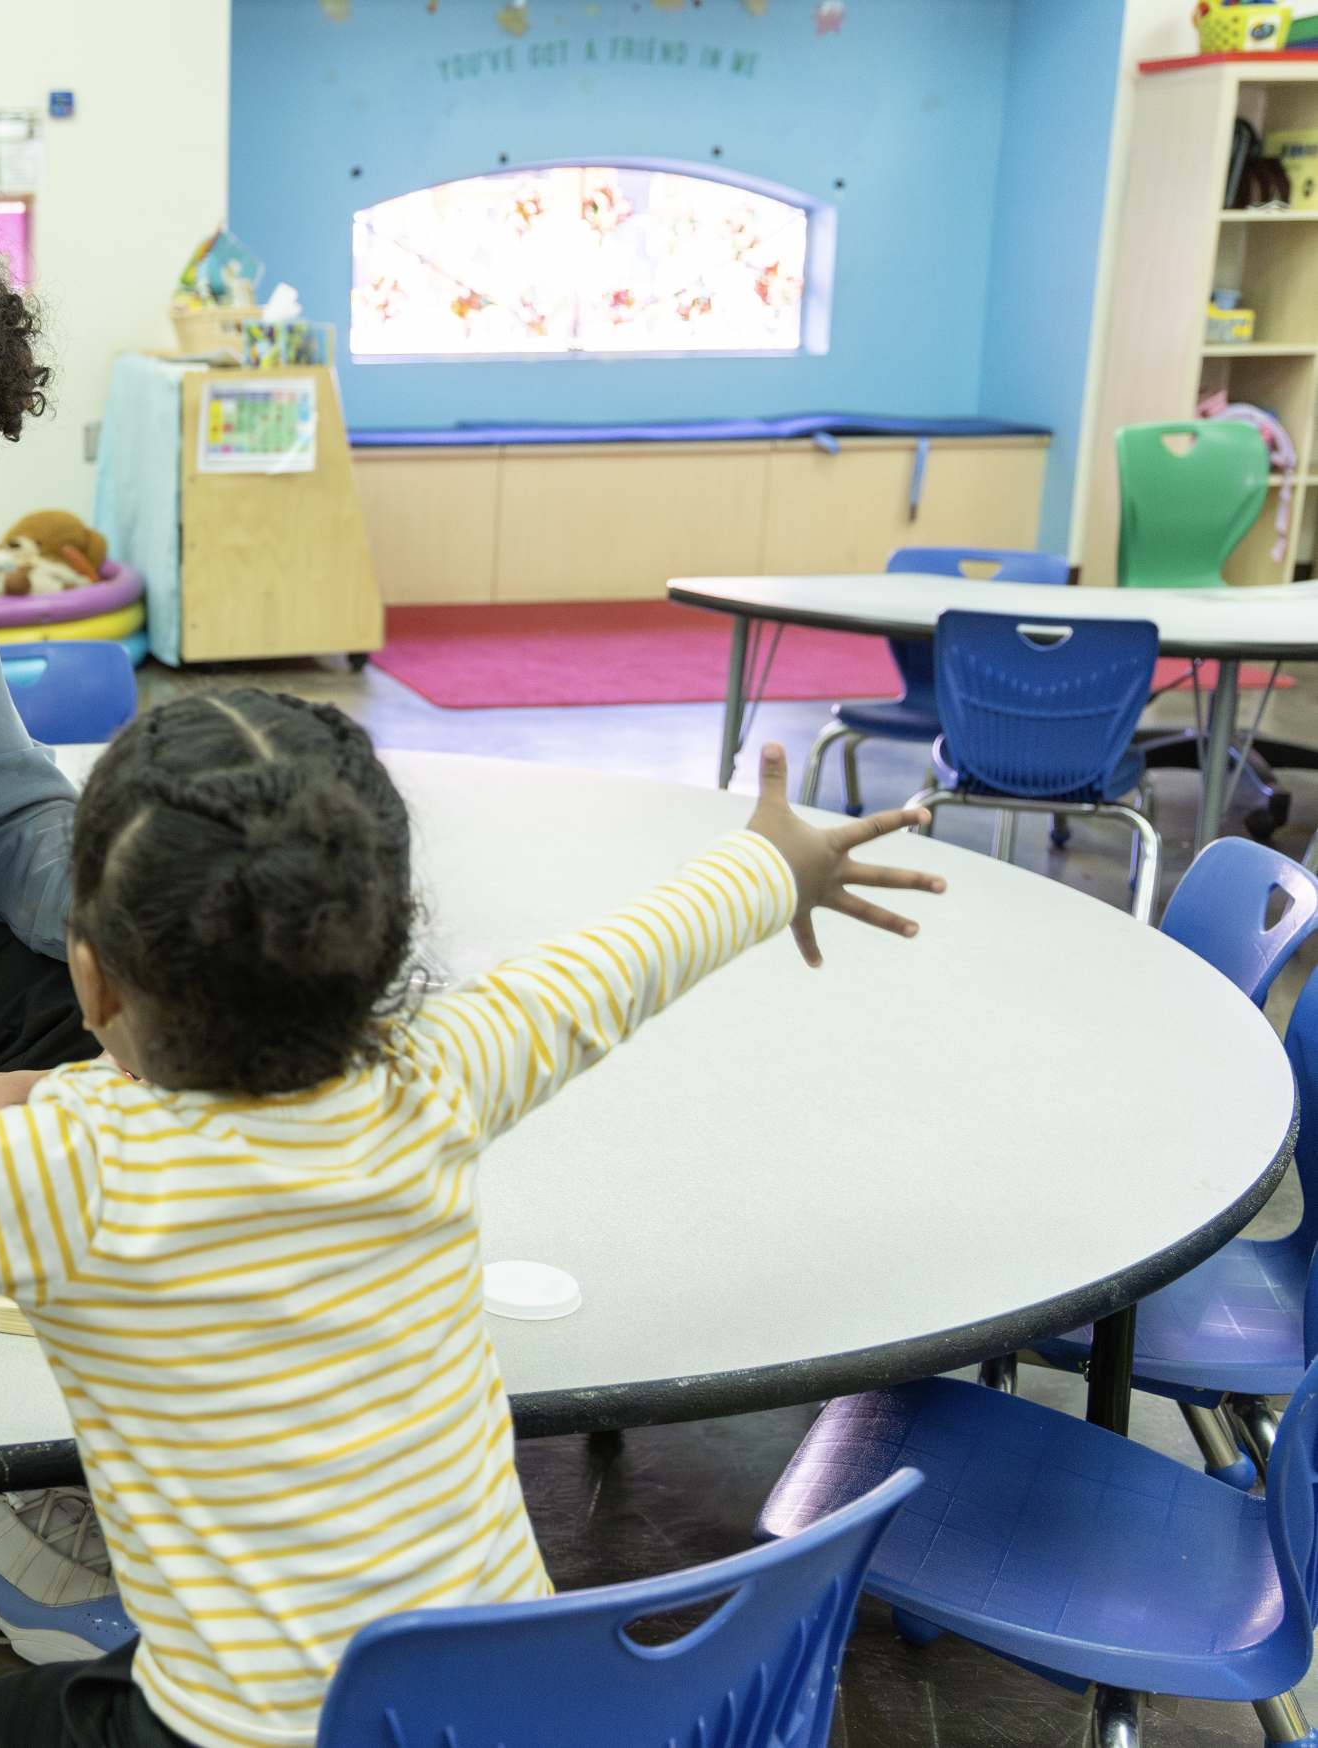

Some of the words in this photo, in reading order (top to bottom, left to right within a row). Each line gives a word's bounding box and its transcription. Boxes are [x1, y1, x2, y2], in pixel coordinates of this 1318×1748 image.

[436, 44, 516, 81] YOU'VE
[528, 40, 568, 69] GOT
[584, 38, 598, 62] A
[609, 37, 688, 66] FRIEND
[699, 46, 722, 70] IN
[730, 49, 760, 78] ME
